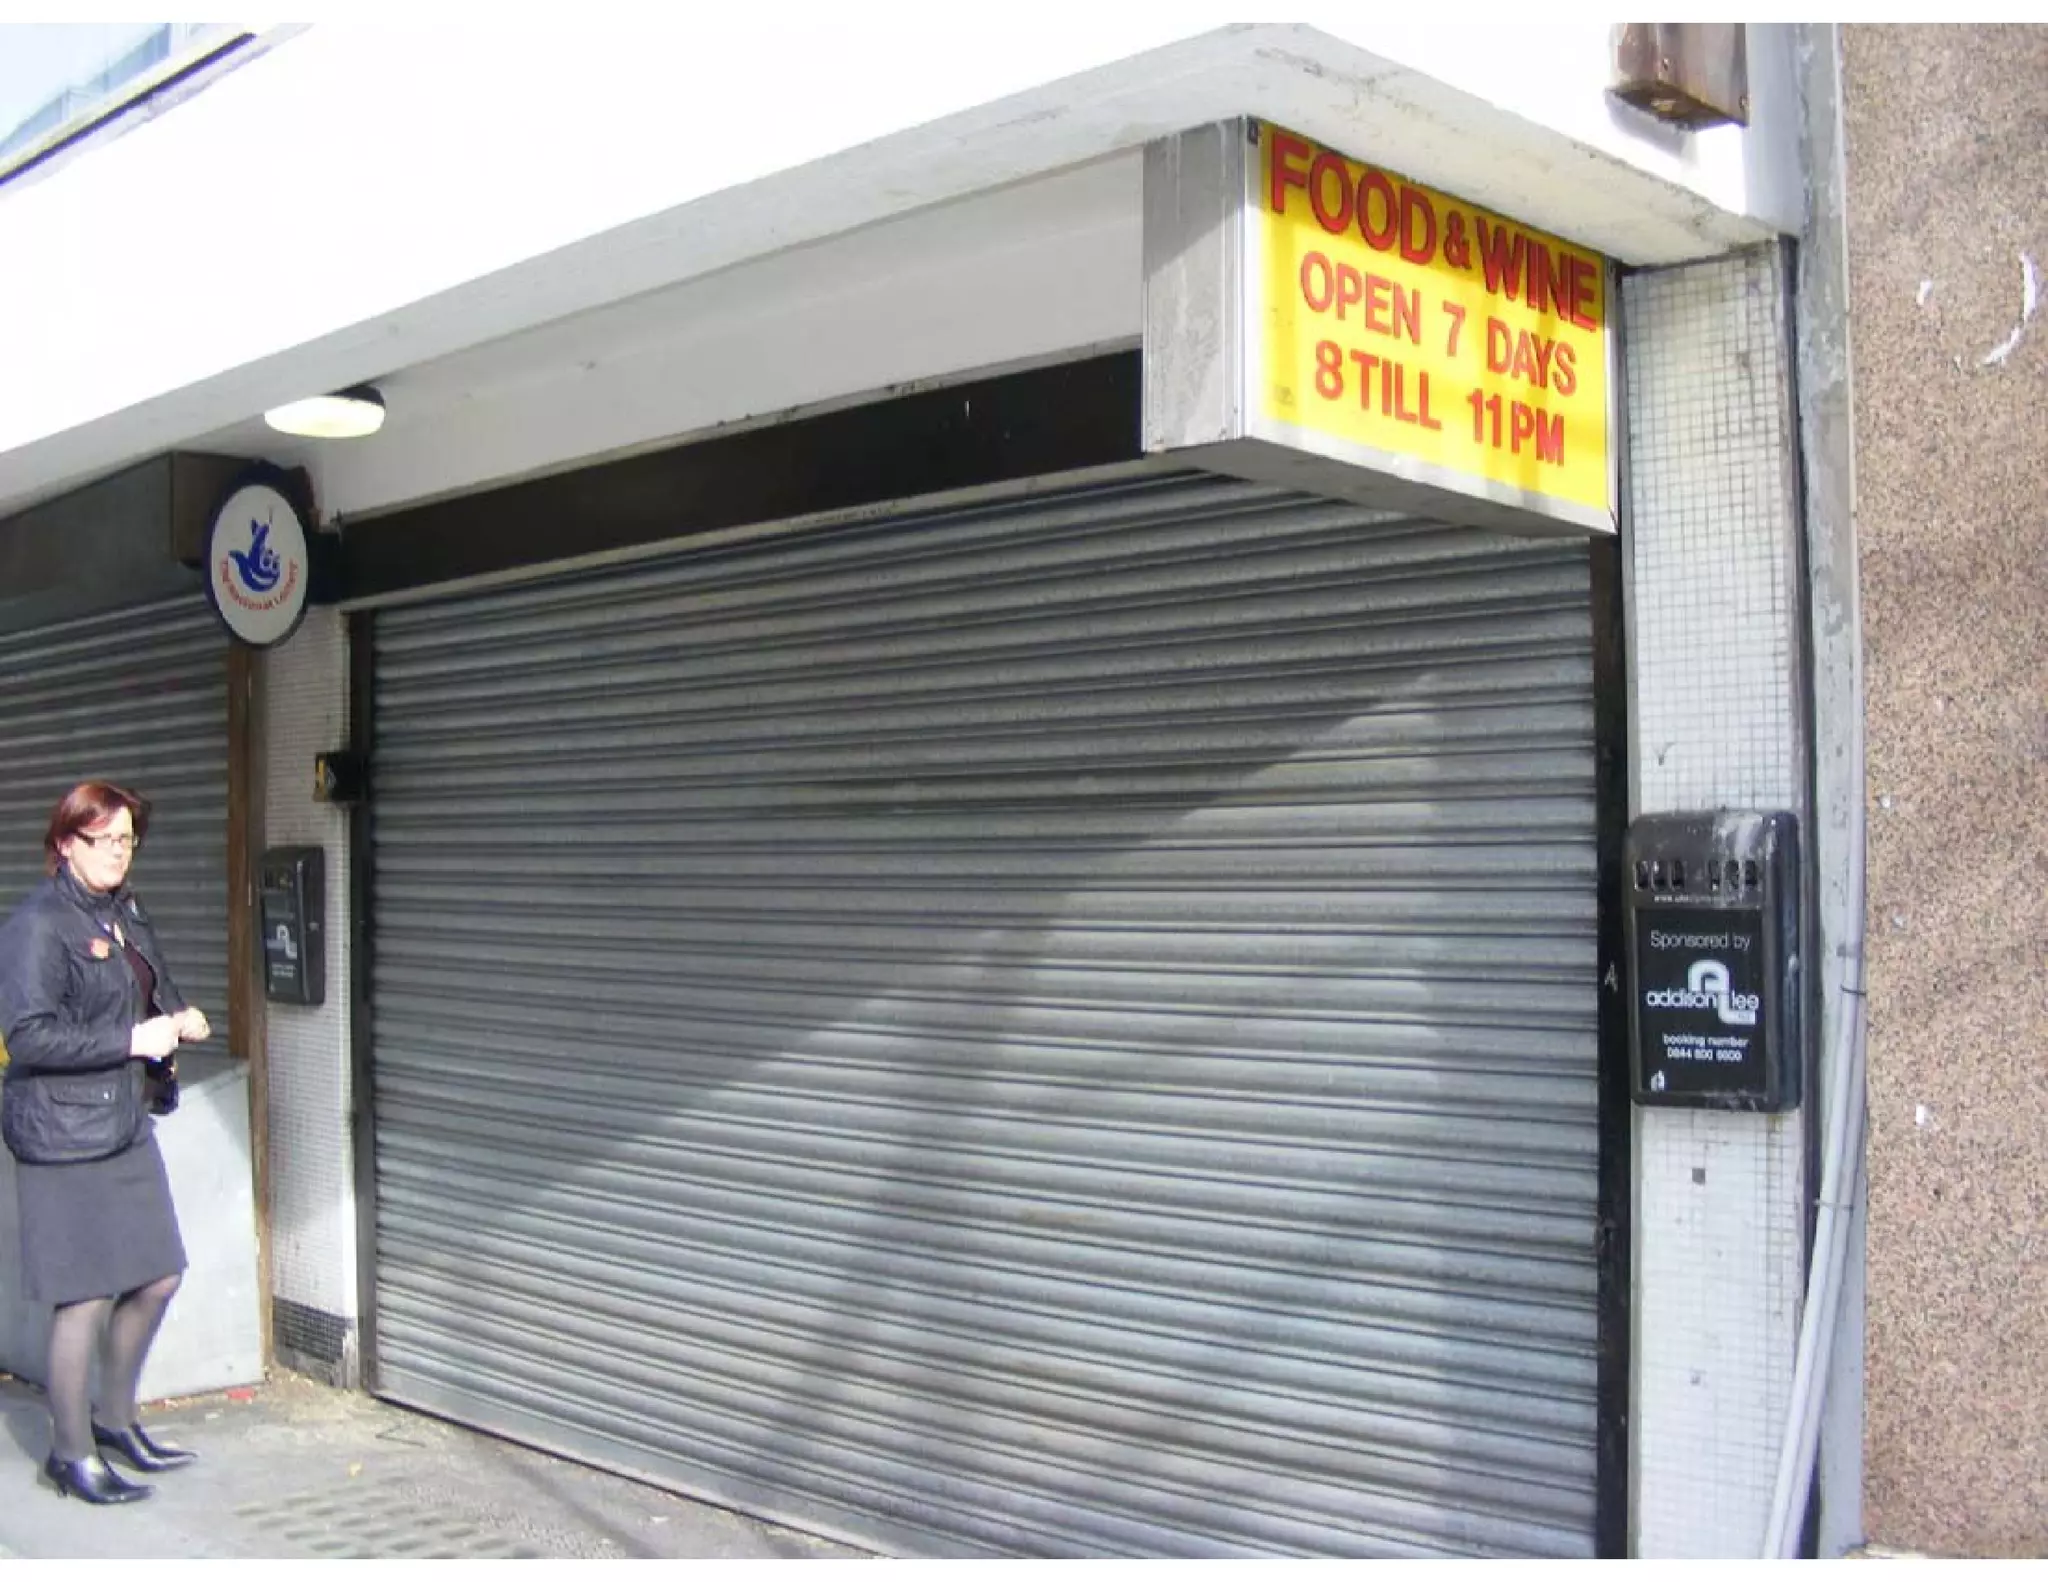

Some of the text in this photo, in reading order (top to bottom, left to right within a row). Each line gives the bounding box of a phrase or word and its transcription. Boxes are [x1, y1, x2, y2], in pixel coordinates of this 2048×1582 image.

[1271, 131, 1598, 333] FOOD & WINE
[1300, 251, 1577, 396] OPEN 7 DAYS
[1315, 341, 1344, 401] 8
[1350, 349, 1443, 431] TILL
[1650, 930, 1751, 953] Sponsored by
[1647, 987, 1760, 1010] addison lee
[1663, 1033, 1749, 1048] booking number
